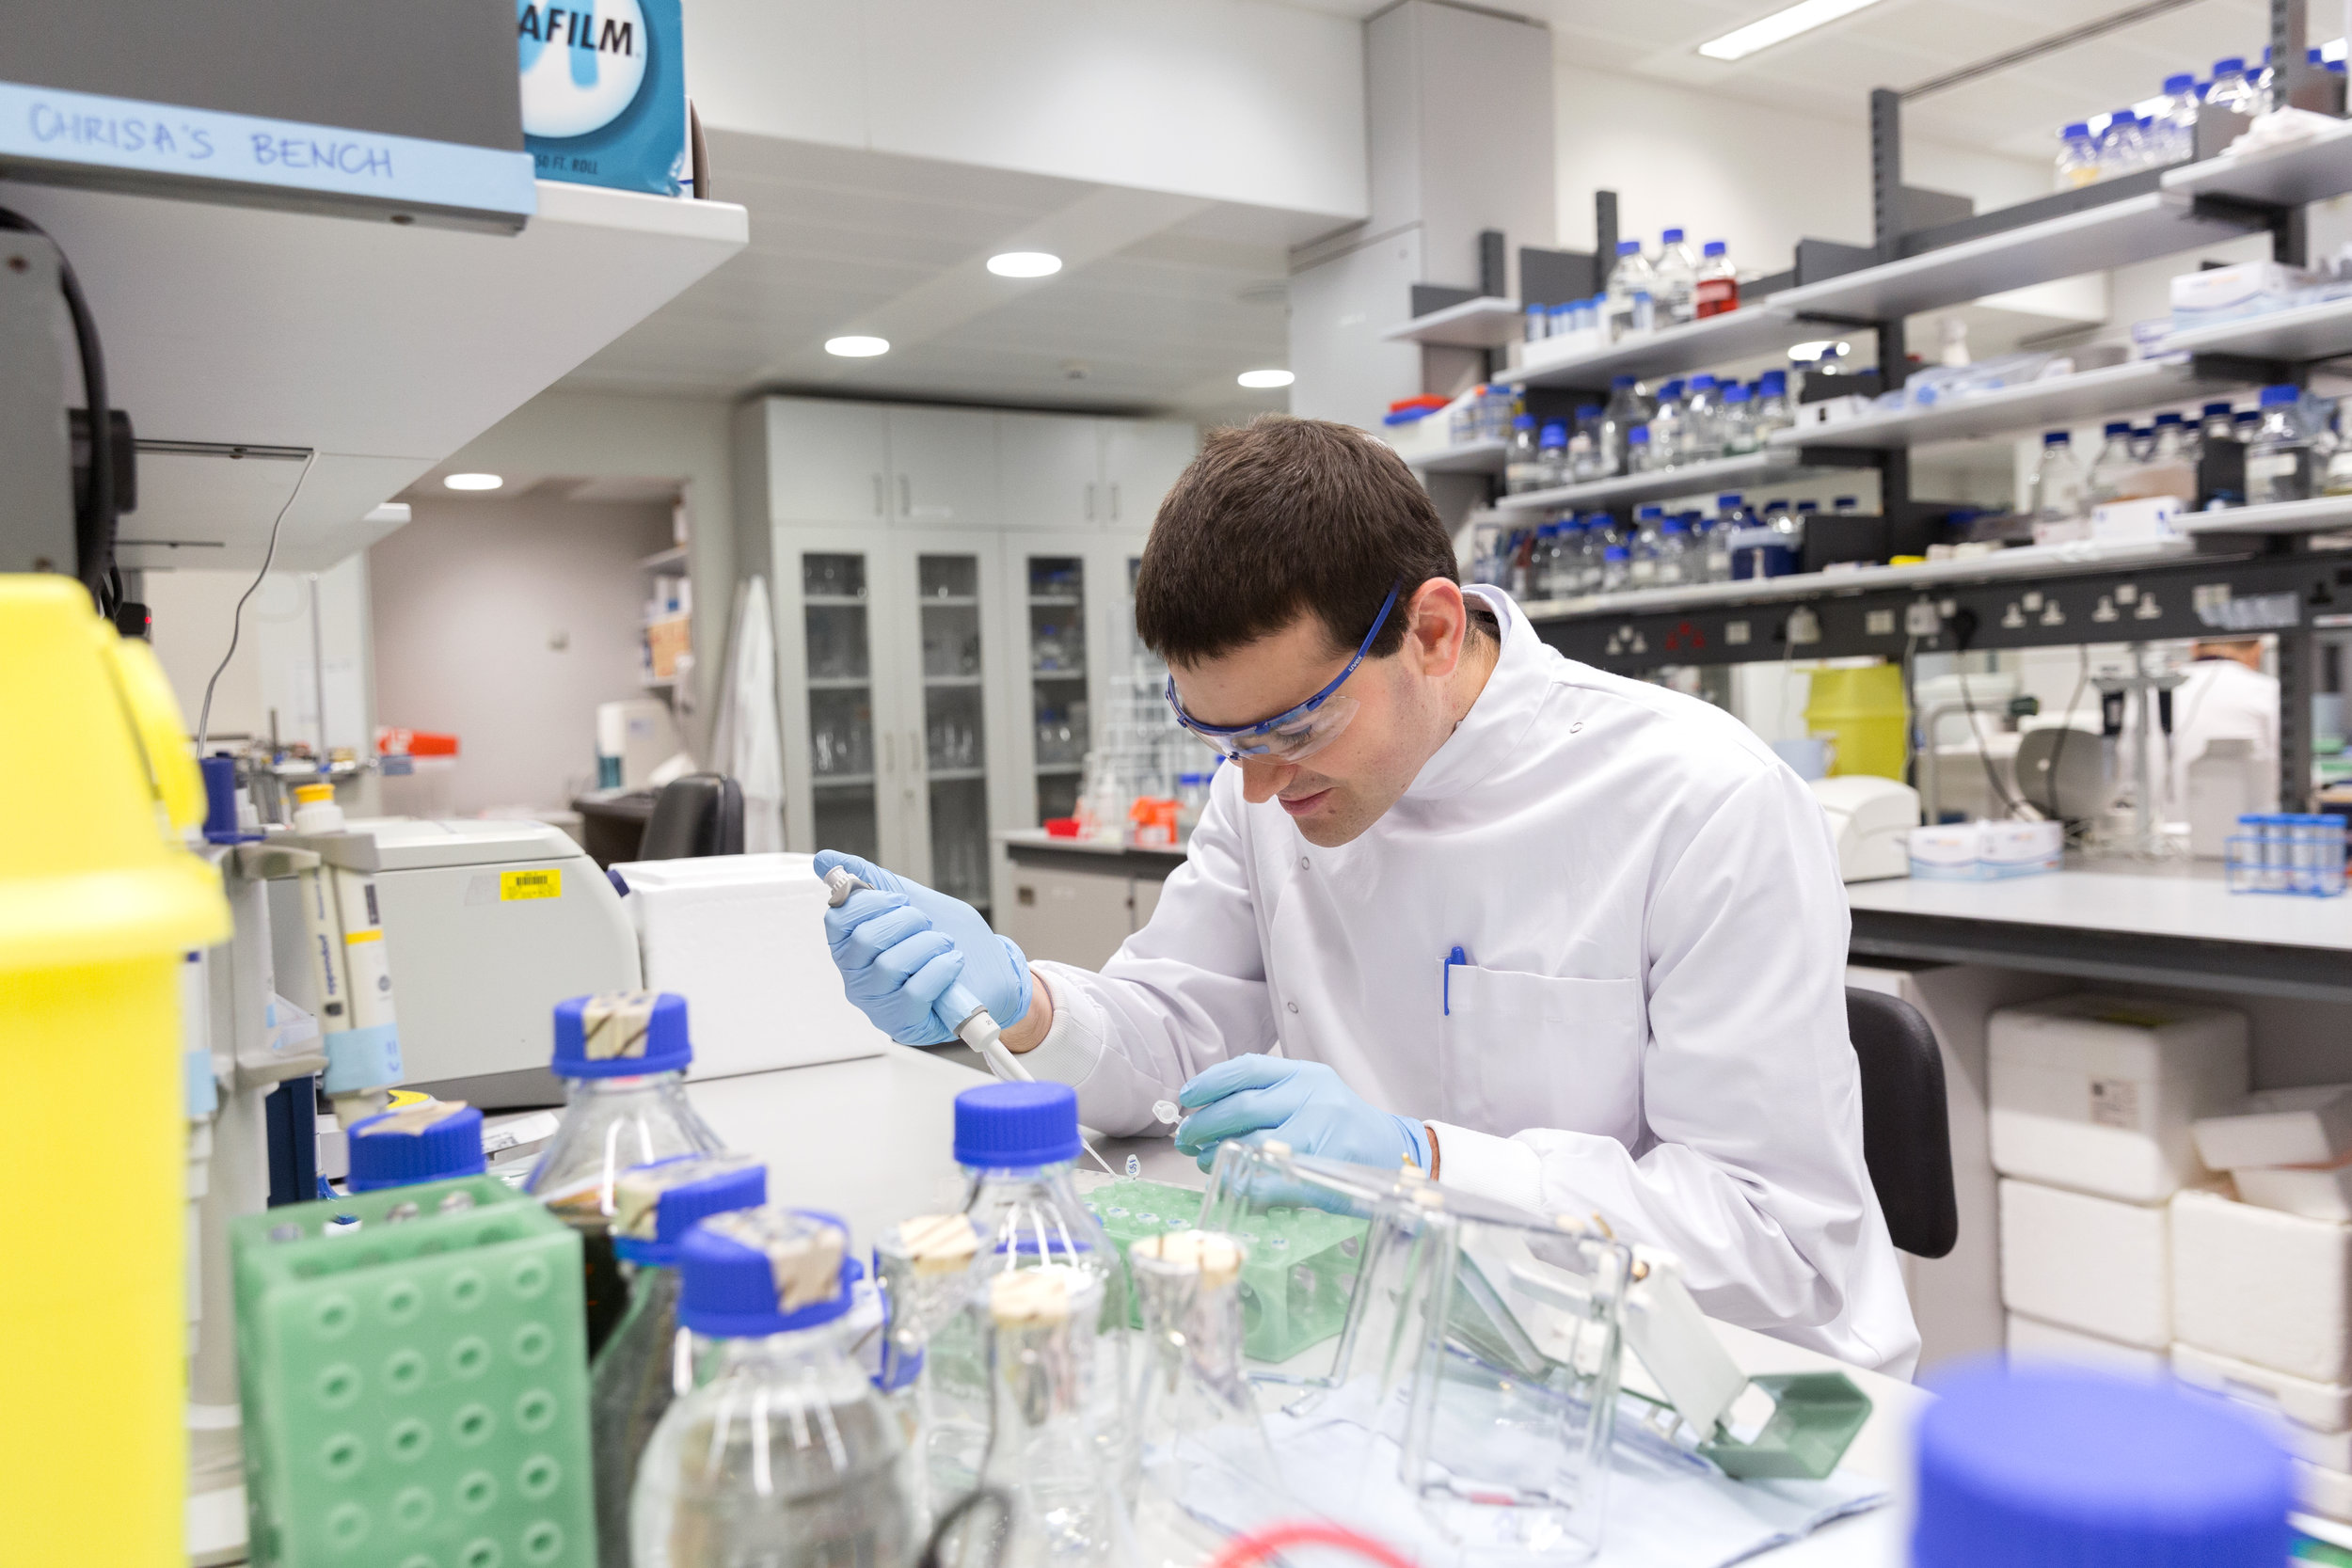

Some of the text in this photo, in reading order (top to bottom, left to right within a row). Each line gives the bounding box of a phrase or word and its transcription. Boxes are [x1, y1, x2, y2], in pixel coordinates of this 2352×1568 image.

[28, 102, 394, 178] CHRISA'S BENCH
[1348, 655, 1362, 672] uvex
